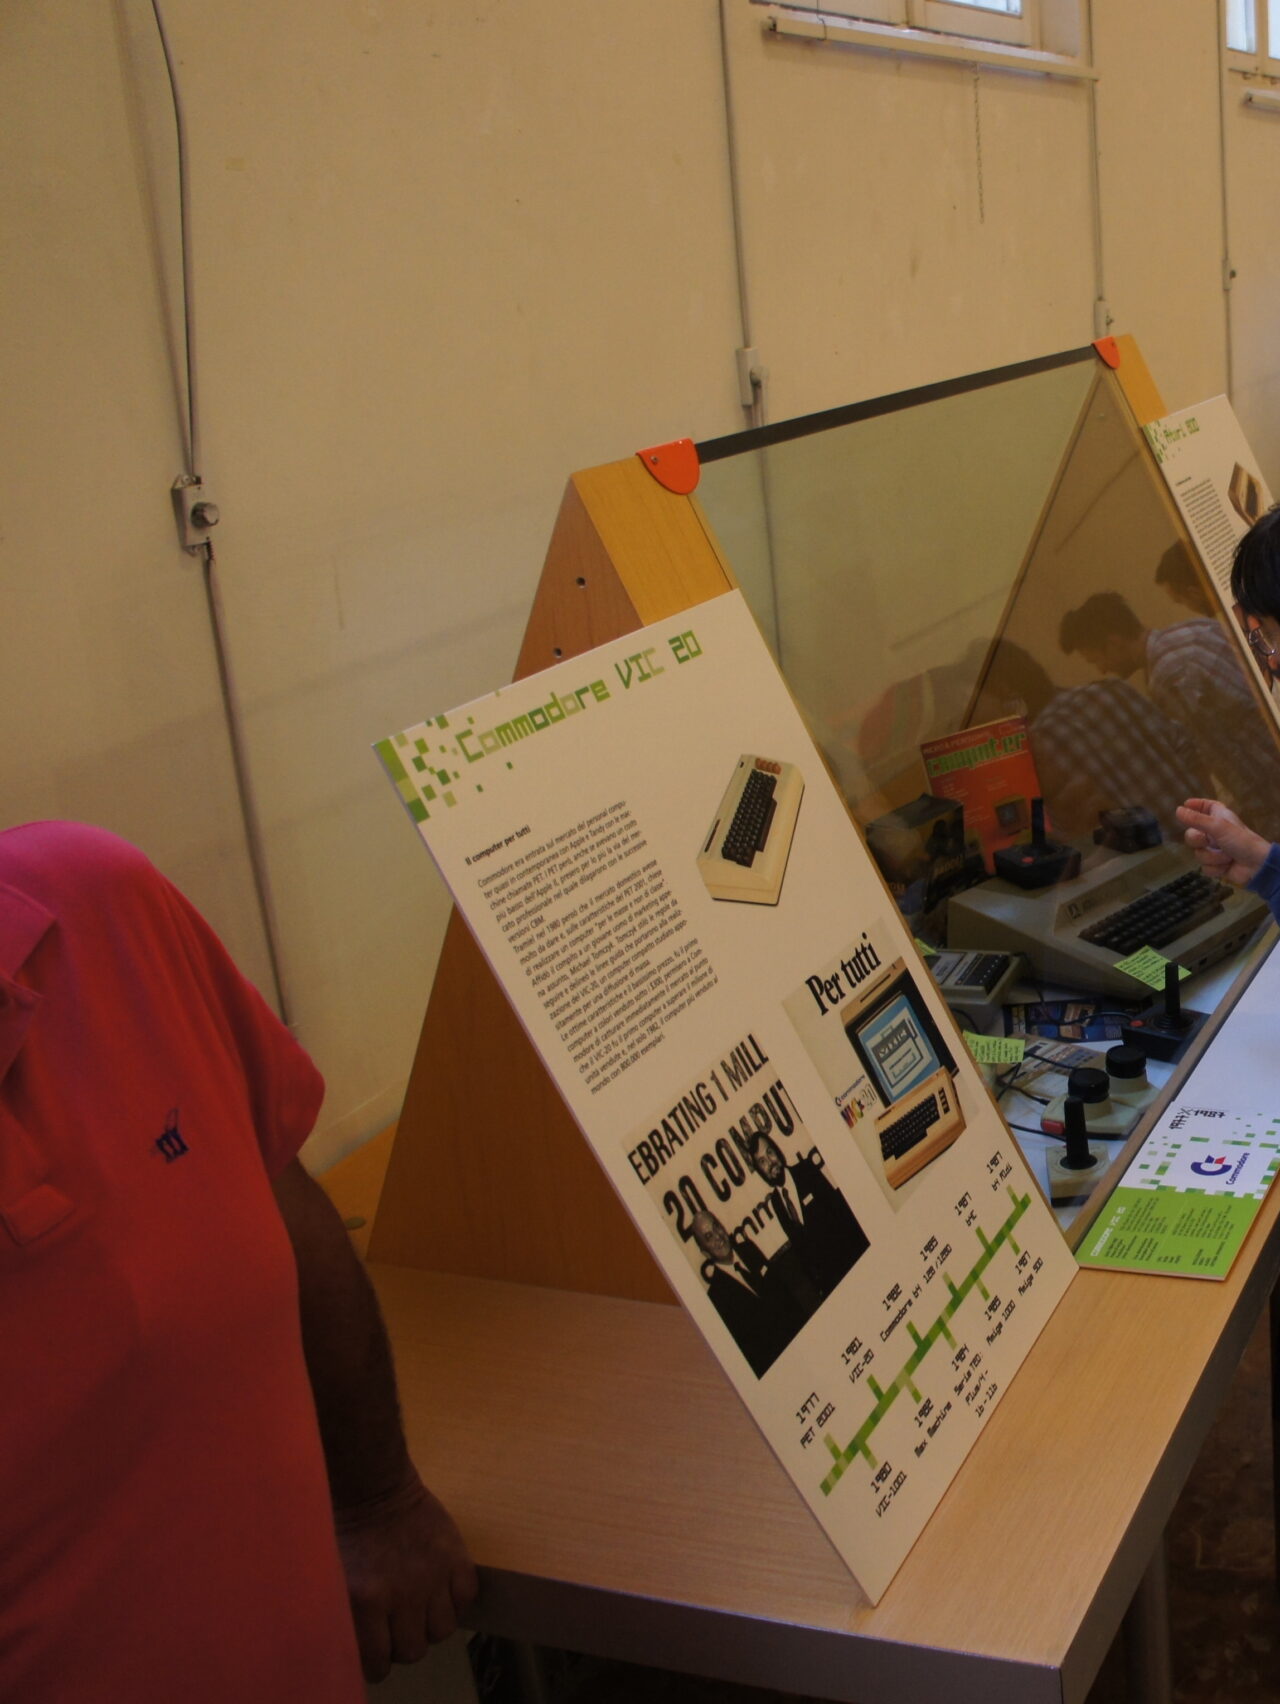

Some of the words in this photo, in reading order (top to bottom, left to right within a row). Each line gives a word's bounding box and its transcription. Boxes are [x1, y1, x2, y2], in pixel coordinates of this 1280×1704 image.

[454, 679, 611, 763] Commodore
[612, 646, 666, 690] VIC
[667, 629, 703, 664] 20
[464, 857, 473, 866] Il
[470, 840, 505, 864] computer
[503, 834, 517, 846] per
[514, 825, 532, 839] tutti
[804, 959, 848, 1017] Per
[835, 930, 881, 991] tutti
[627, 1079, 718, 1185] EBRATING
[708, 1069, 729, 1103] 1
[720, 1033, 769, 1092] MILL
[986, 1149, 1002, 1175] 1987
[1225, 1152, 1251, 1186] Commodore
[662, 1174, 707, 1243] 20
[954, 1190, 972, 1216] 1987
[919, 1233, 938, 1262] 1985
[1014, 1248, 1030, 1275] 1987
[1017, 1270, 1034, 1299] Amiga
[1032, 1255, 1043, 1274] 500
[882, 1281, 902, 1311] 1982
[984, 1293, 1001, 1322] 1985
[879, 1294, 913, 1343] Commodore
[985, 1317, 1004, 1348] Amiga
[1001, 1298, 1016, 1322] 1000
[840, 1333, 862, 1366] 1981
[848, 1347, 874, 1385] VIC-20
[951, 1341, 969, 1372] 1984
[953, 1366, 972, 1398] Serie
[964, 1371, 986, 1408] Plus/4
[795, 1390, 819, 1425] 1977
[799, 1425, 816, 1450] PET
[815, 1399, 835, 1429] 2001
[913, 1396, 934, 1429] 1982
[914, 1435, 928, 1459] Max
[926, 1397, 952, 1439] Machine
[870, 1459, 892, 1495] 1980
[875, 1467, 907, 1520] VIC-1001
